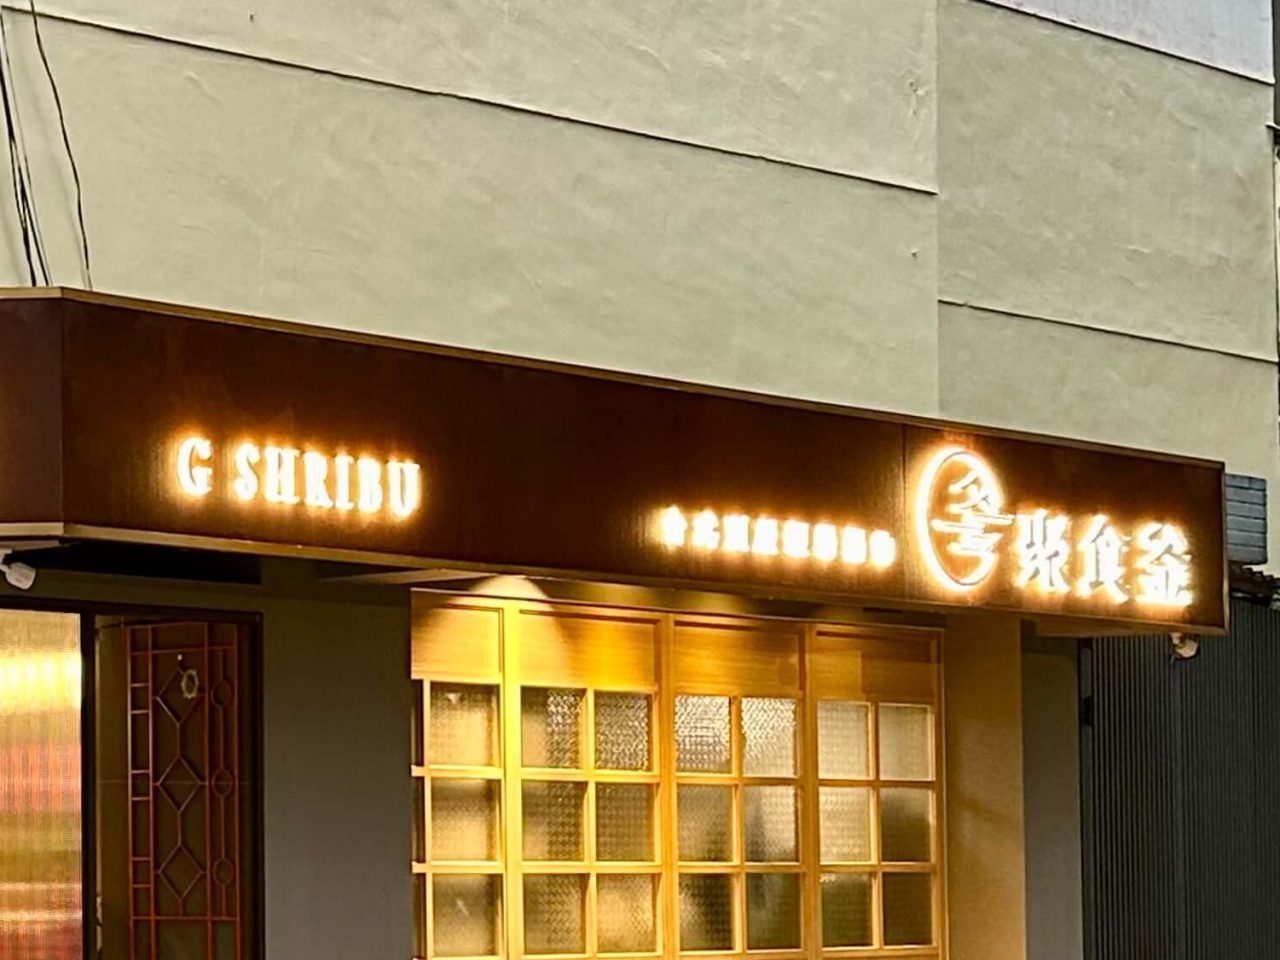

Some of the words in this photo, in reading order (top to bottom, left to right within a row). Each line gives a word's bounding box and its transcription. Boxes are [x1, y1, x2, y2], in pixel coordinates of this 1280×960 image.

[176, 436, 214, 497] G
[234, 442, 421, 519] SHRIBU
[1014, 507, 1194, 608] 聚食釜
